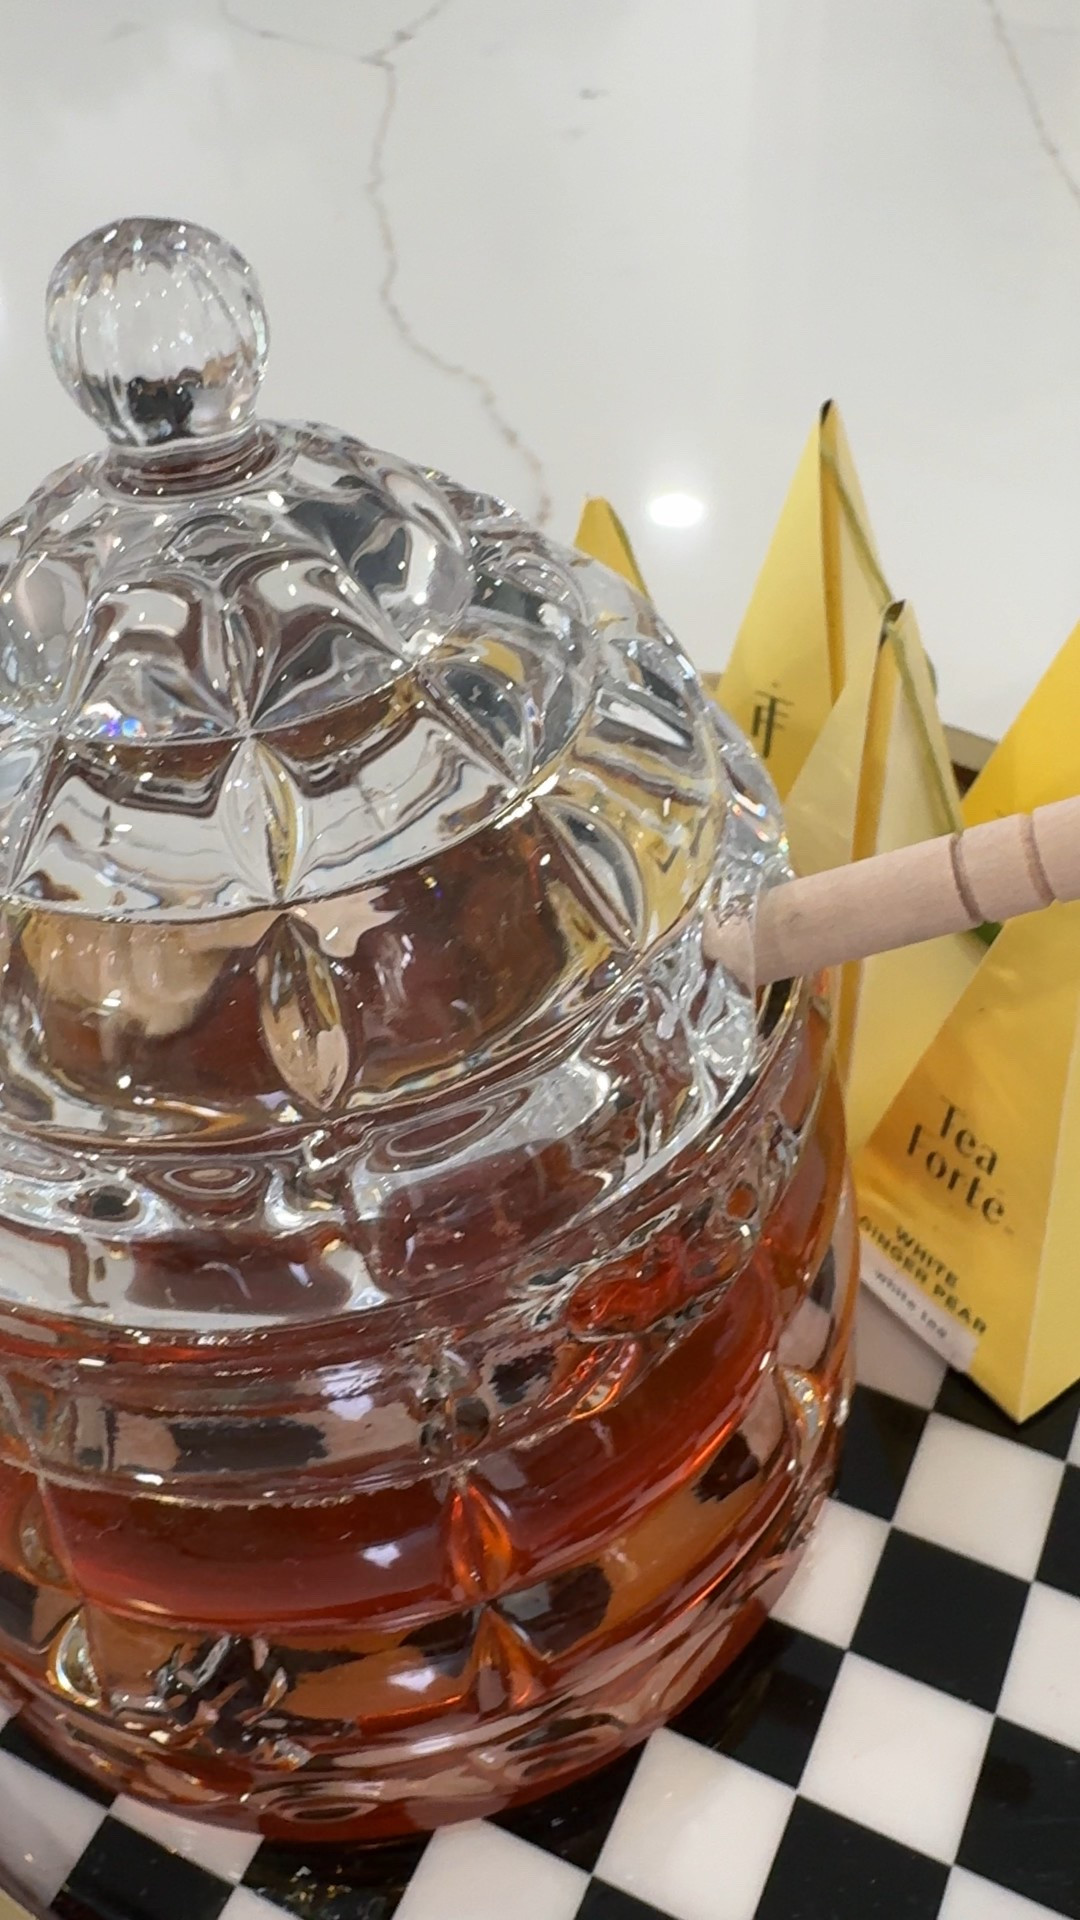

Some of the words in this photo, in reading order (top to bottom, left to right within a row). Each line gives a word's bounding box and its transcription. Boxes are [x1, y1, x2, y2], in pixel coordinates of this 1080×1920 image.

[940, 1096, 998, 1176] Tea
[896, 1225, 958, 1287] WHITE
[875, 1271, 917, 1311] white
[920, 1309, 948, 1339] tea
[933, 1283, 987, 1334] PEAR
